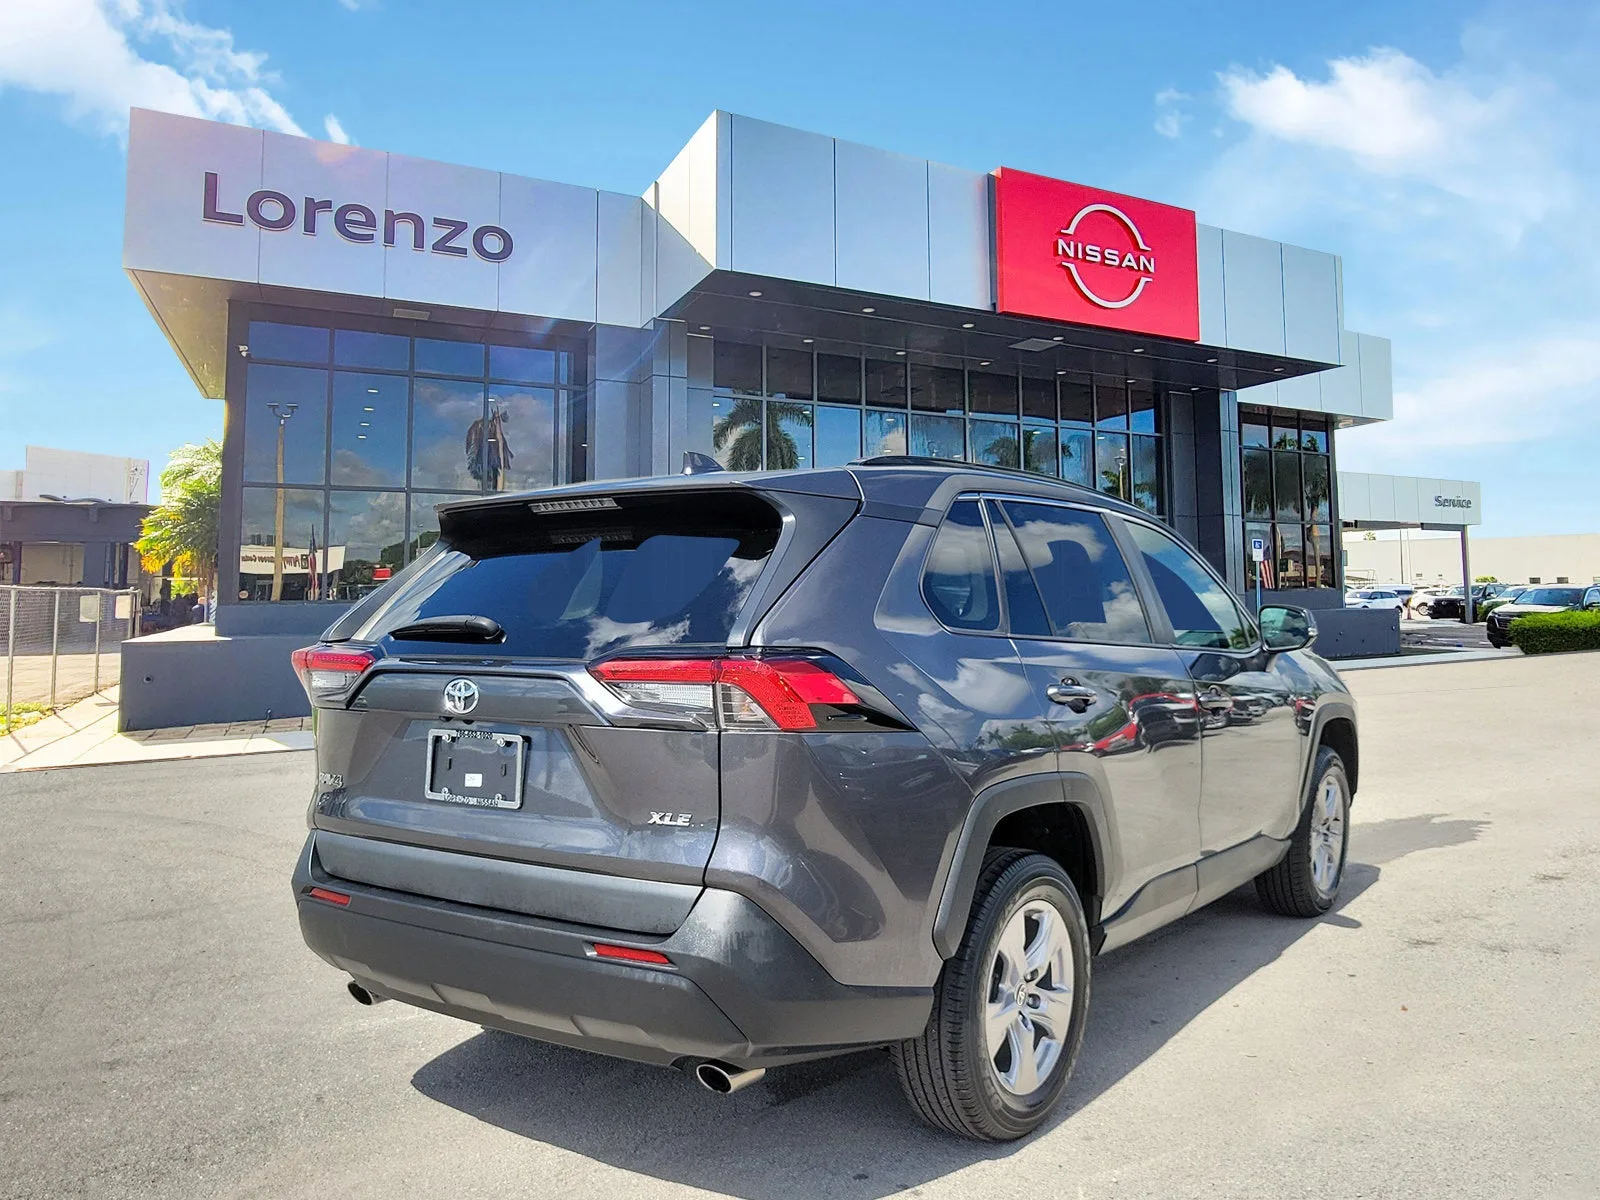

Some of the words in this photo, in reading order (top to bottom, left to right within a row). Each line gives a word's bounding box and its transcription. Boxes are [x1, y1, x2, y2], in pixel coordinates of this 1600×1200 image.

[202, 170, 514, 263] Lorenzo
[1056, 237, 1155, 273] NISSAN
[1434, 494, 1472, 509] Service
[647, 811, 693, 827] XLE
